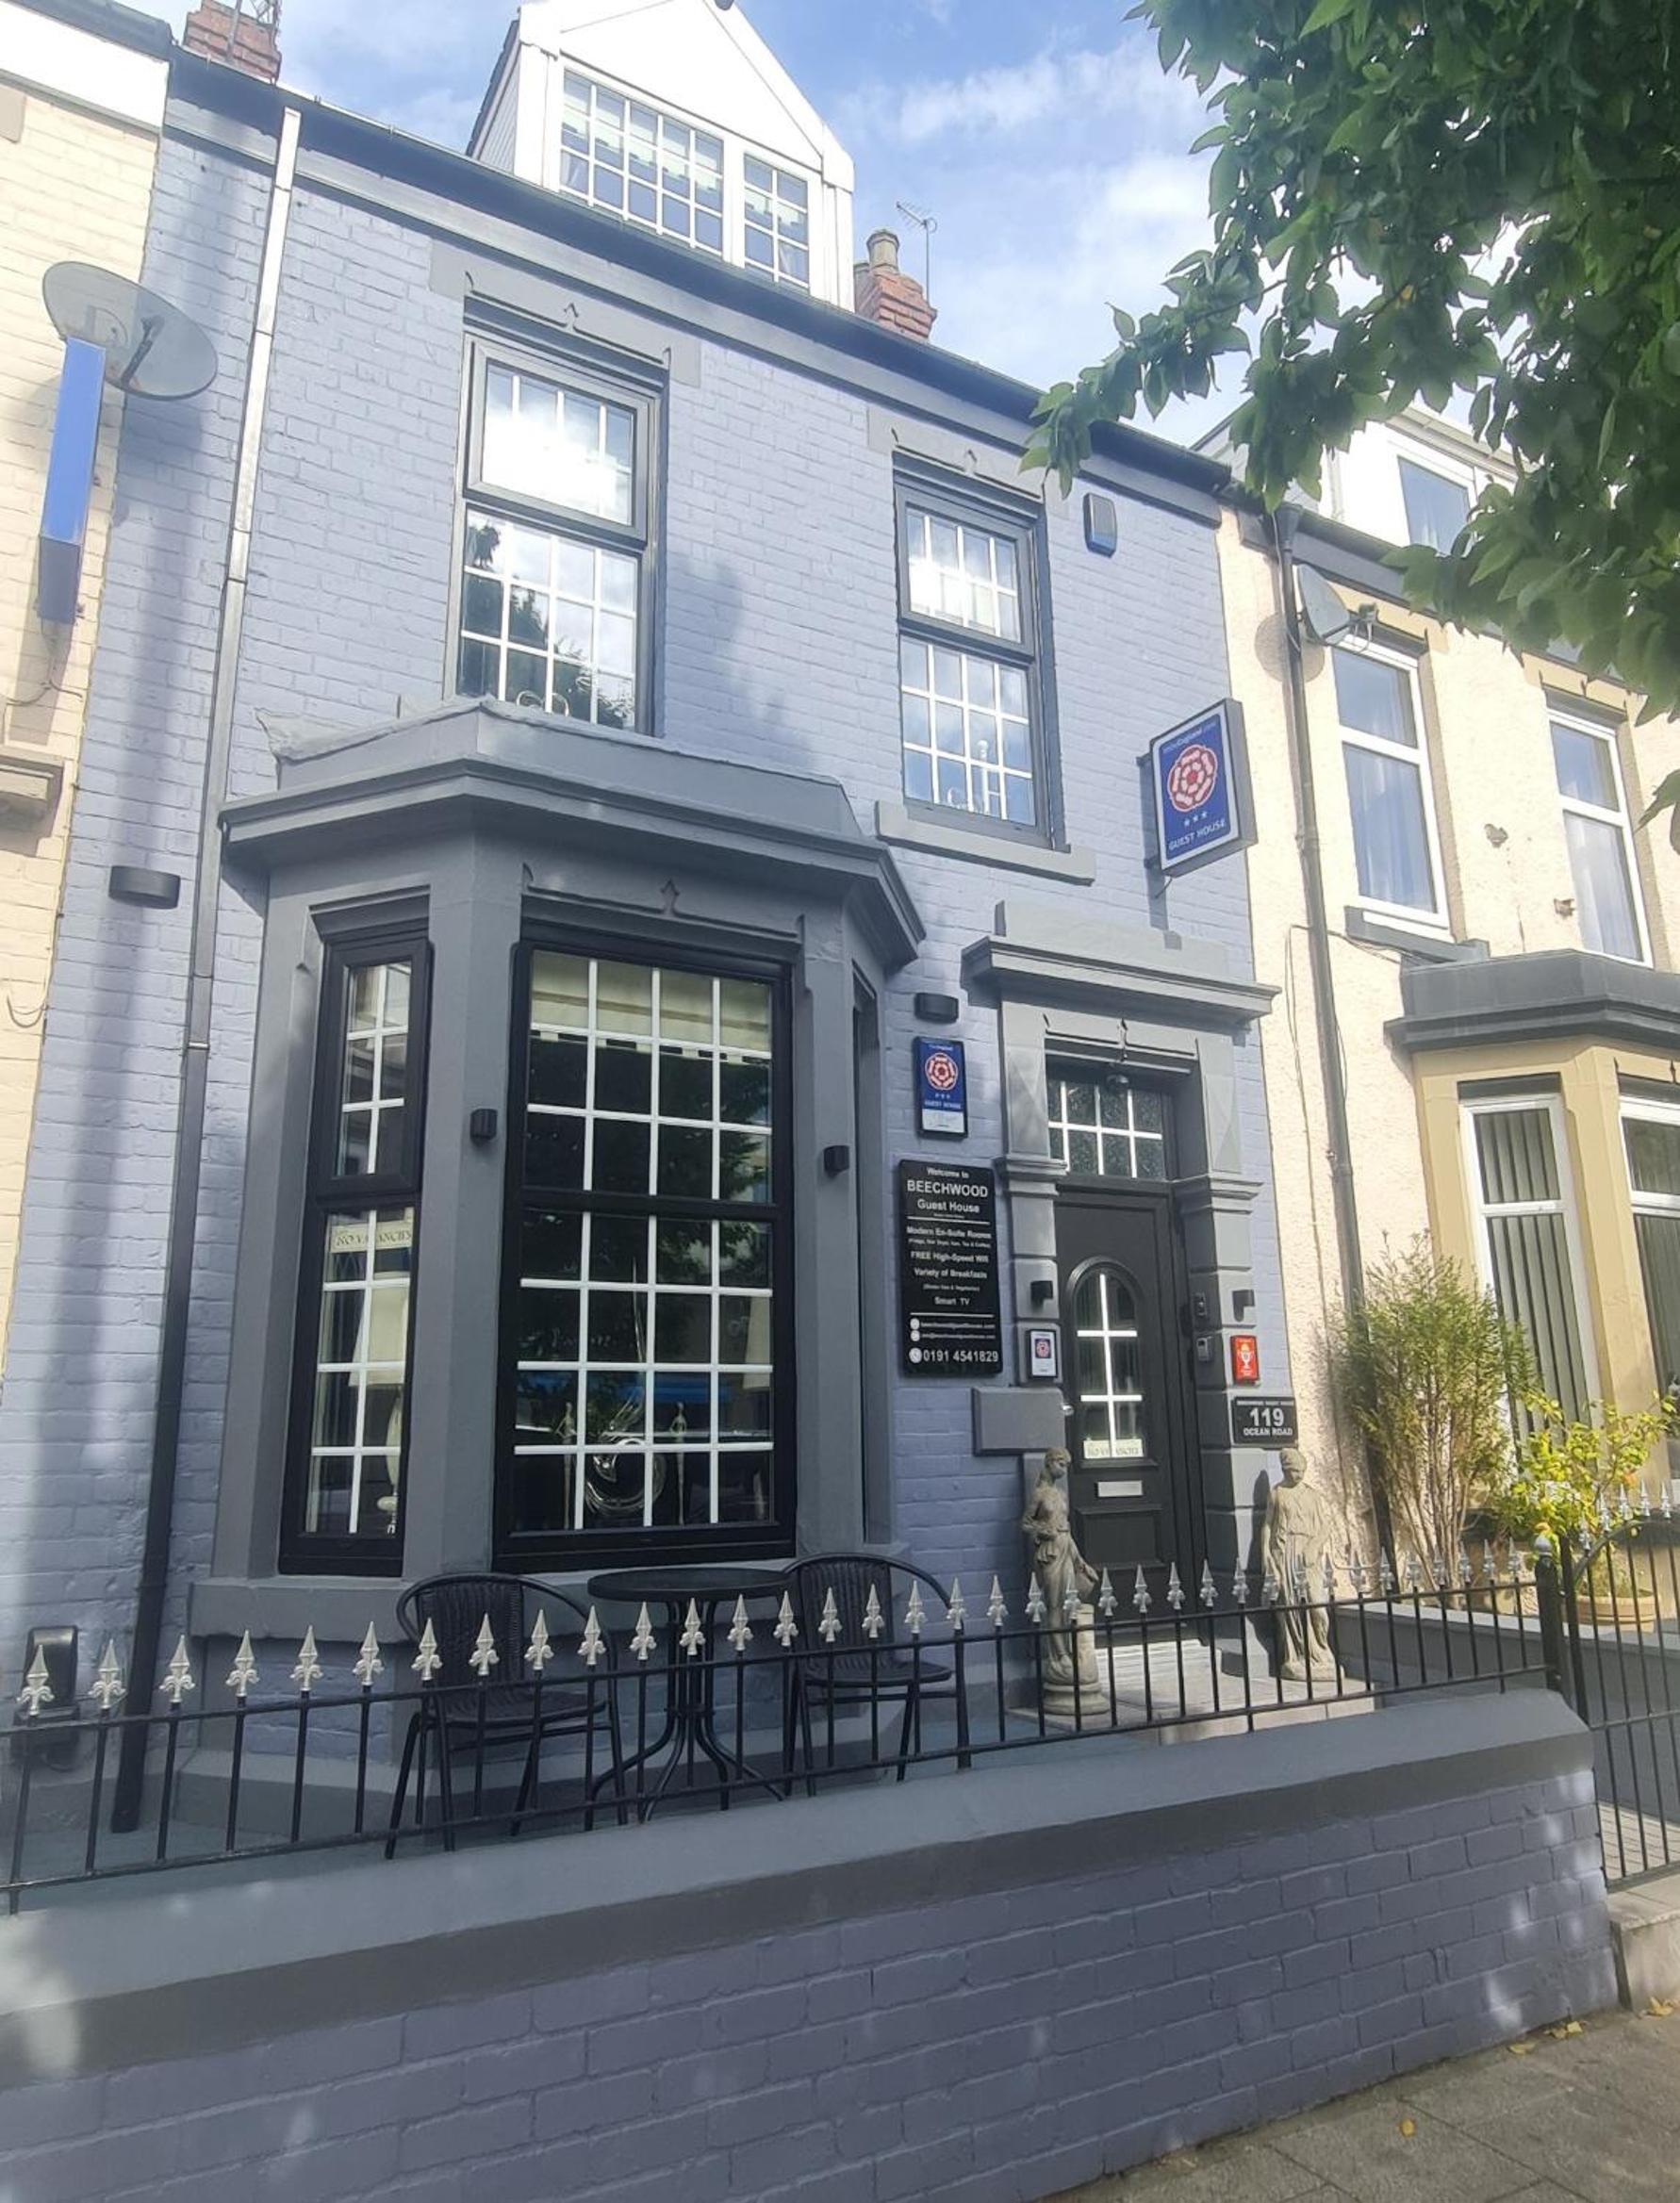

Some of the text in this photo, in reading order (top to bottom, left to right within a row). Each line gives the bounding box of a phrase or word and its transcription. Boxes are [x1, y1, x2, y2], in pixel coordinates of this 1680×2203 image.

[1168, 818, 1226, 850] GUEST HOUSE
[907, 1179, 988, 1197] BEECHWOOD
[917, 1198, 980, 1213] Guest House
[911, 1251, 931, 1259] FREE
[914, 1267, 939, 1278] Variety
[934, 1296, 970, 1306] Smart TV
[924, 1349, 999, 1362] 0191 4541829
[1249, 1407, 1284, 1426] 119
[1244, 1426, 1293, 1436] OCEAN ROAD
